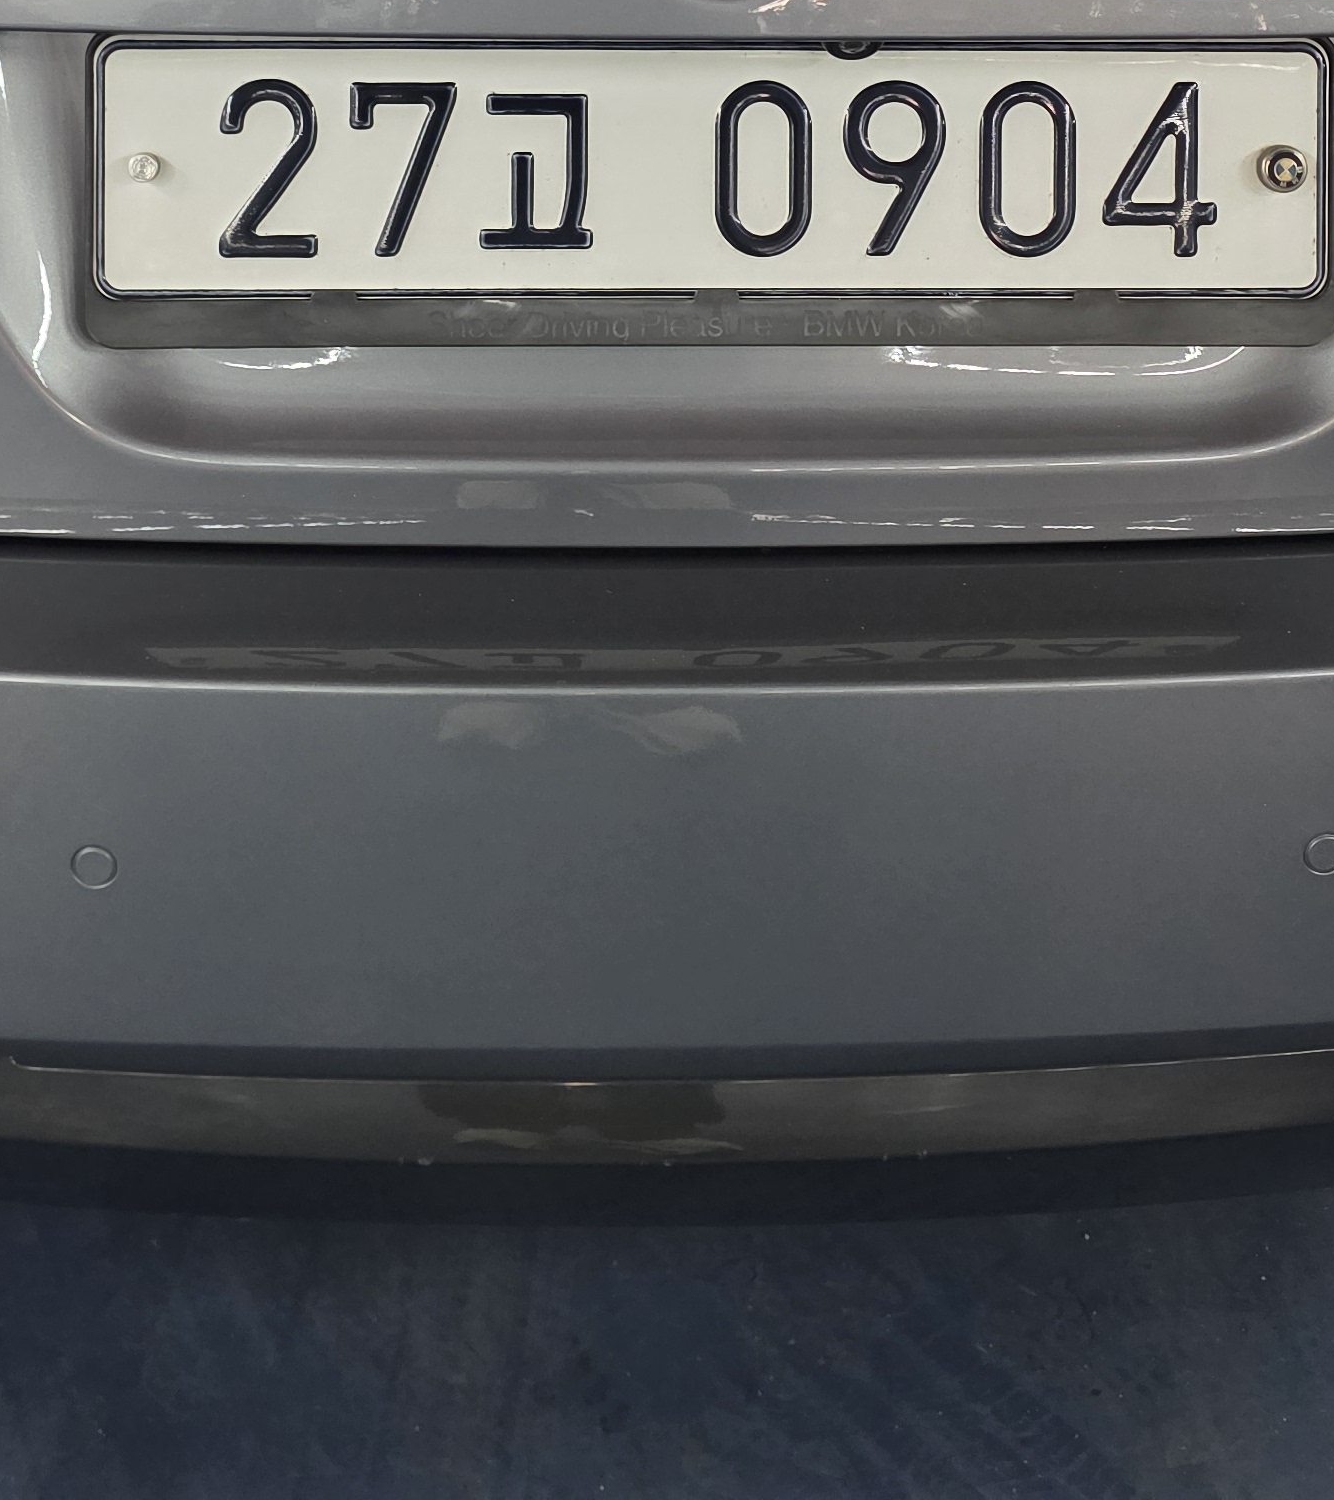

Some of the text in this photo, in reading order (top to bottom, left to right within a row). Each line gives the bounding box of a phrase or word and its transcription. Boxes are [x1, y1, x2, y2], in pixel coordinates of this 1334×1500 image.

[218, 78, 1218, 259] 27고 0904
[527, 311, 630, 343] Driving
[641, 310, 773, 338] Pleasue
[803, 309, 887, 338] BMW
